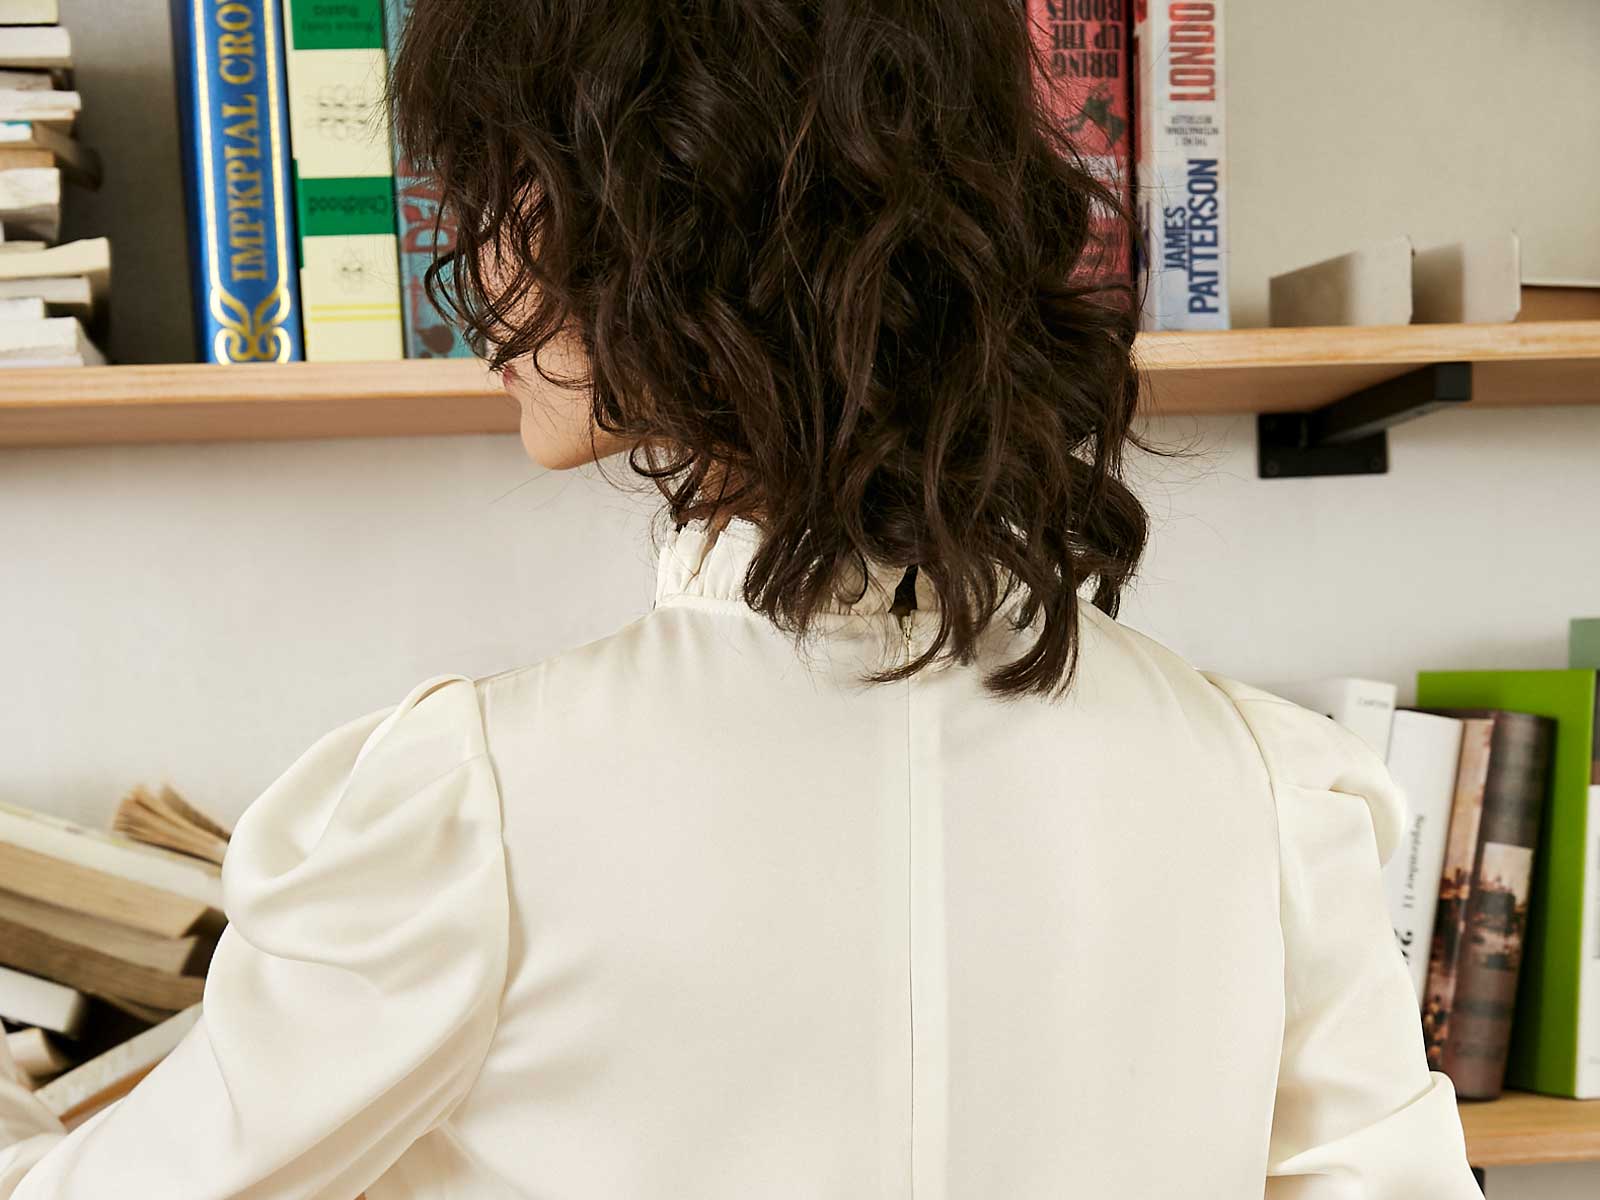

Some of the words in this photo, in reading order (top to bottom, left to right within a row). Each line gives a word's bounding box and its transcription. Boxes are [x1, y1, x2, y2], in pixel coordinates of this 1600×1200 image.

[215, 0, 255, 85] CRO
[1051, 23, 1087, 49] THE
[1093, 23, 1121, 50] UP
[1052, 52, 1119, 78] BRING
[1163, 206, 1187, 270] JAMES
[1187, 158, 1219, 314] PATTERSON
